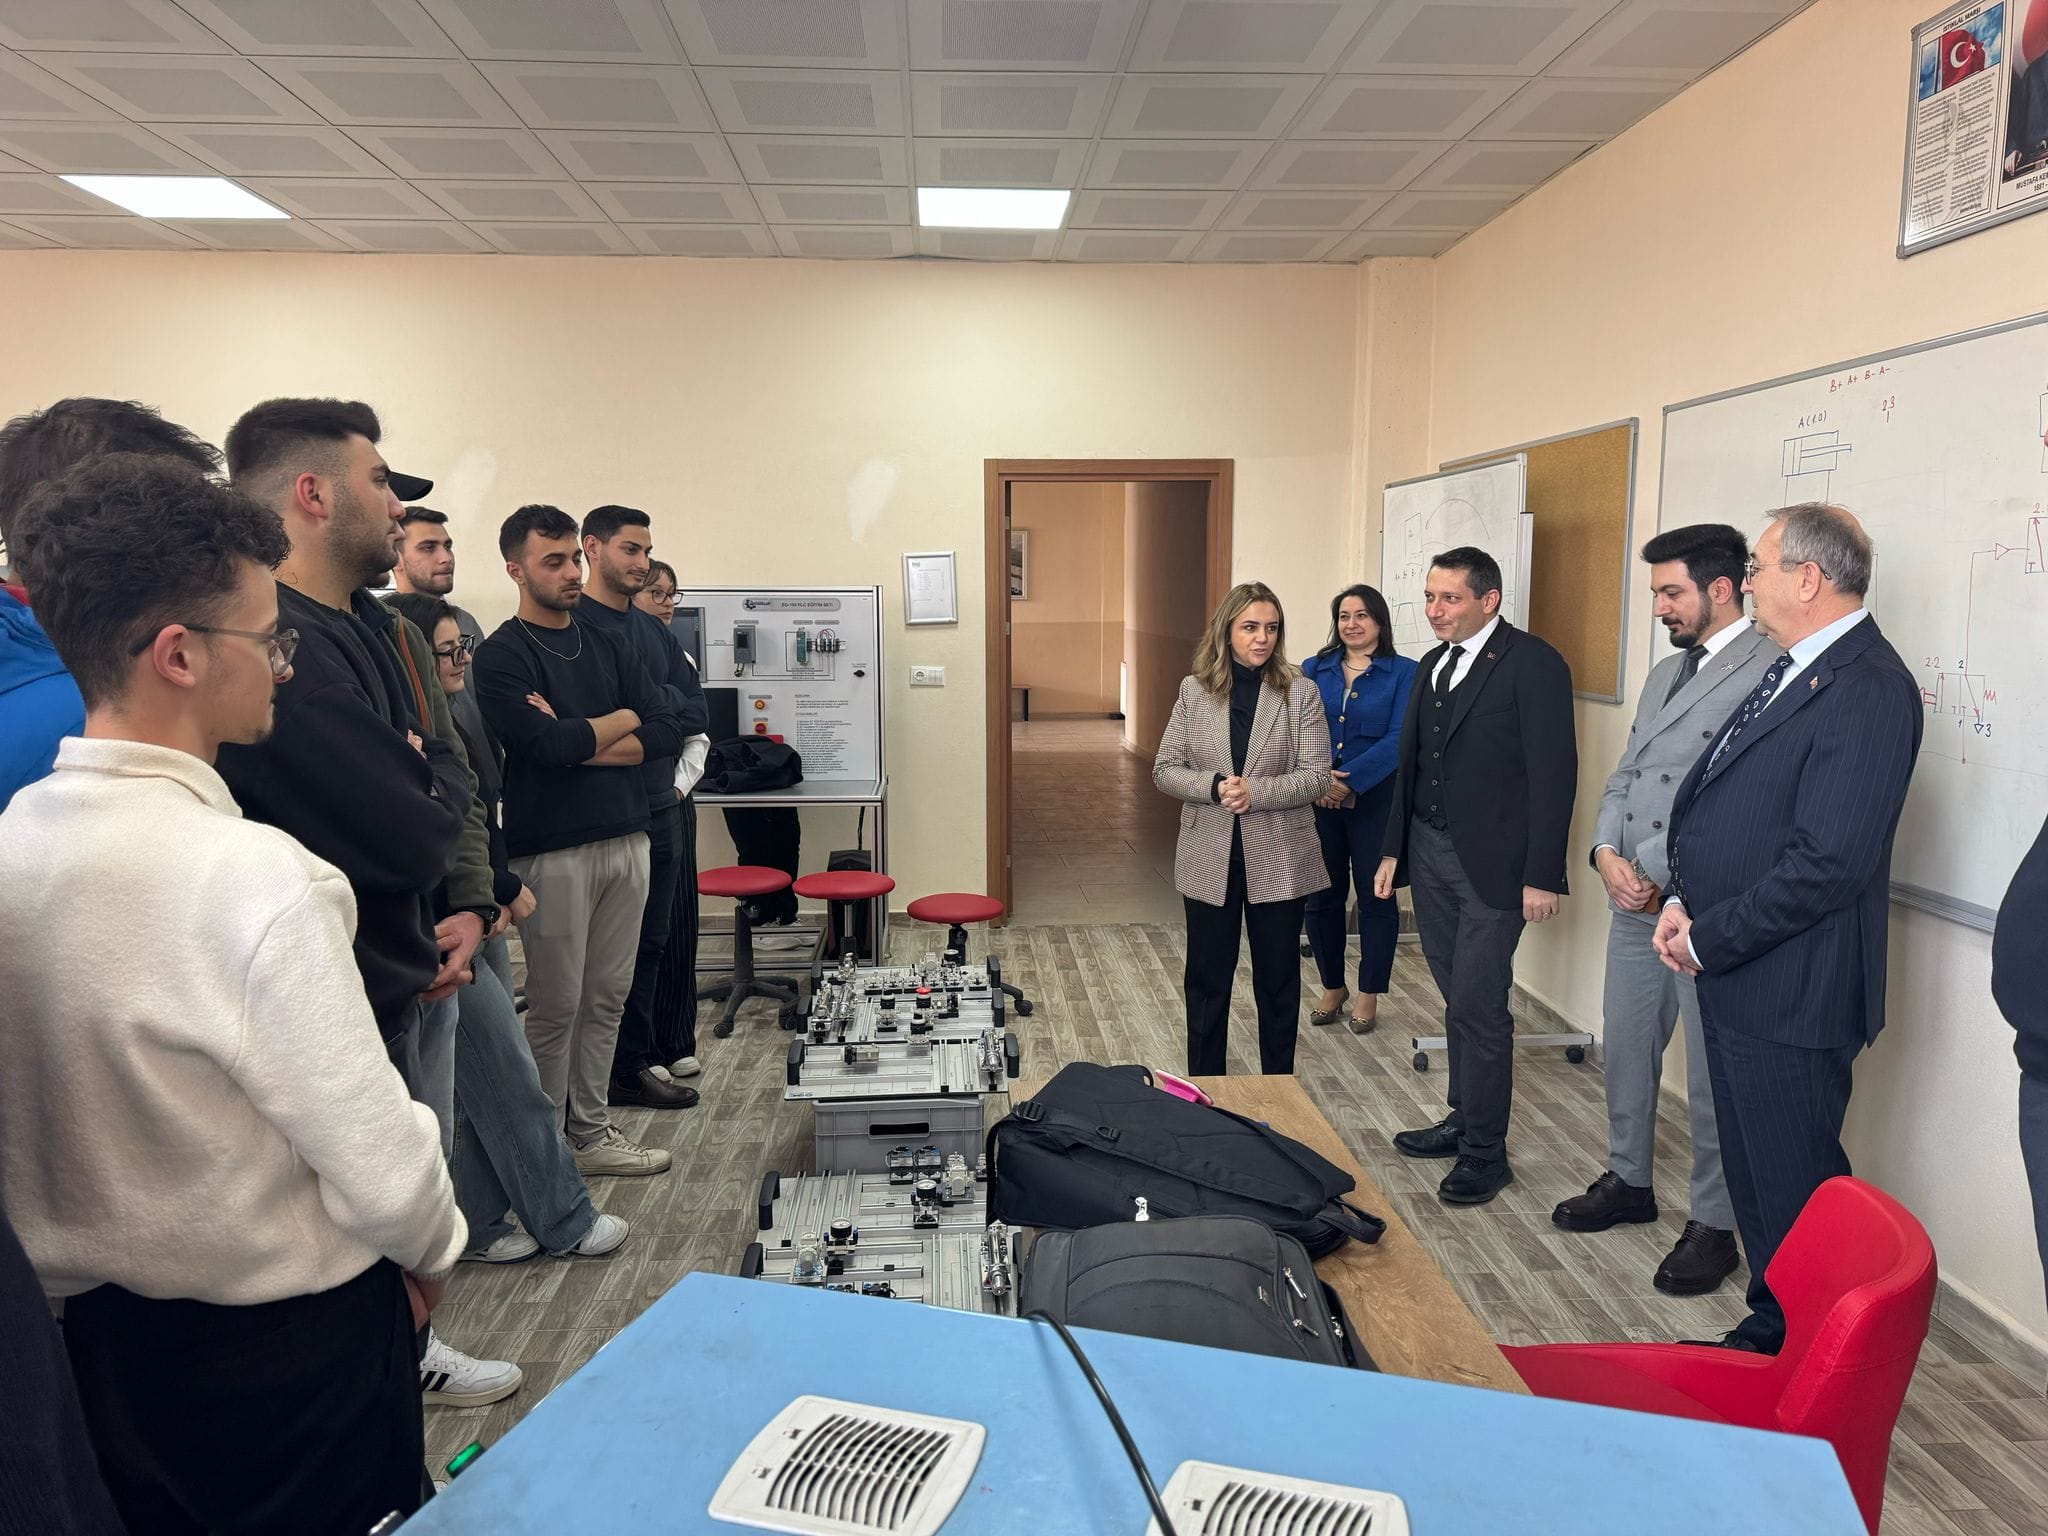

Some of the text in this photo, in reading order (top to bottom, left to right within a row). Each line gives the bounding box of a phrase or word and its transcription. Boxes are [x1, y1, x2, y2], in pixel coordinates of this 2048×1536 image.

[1829, 379, 1842, 393] B+
[1958, 660, 1964, 669] 2
[1985, 723, 1992, 737] 3
